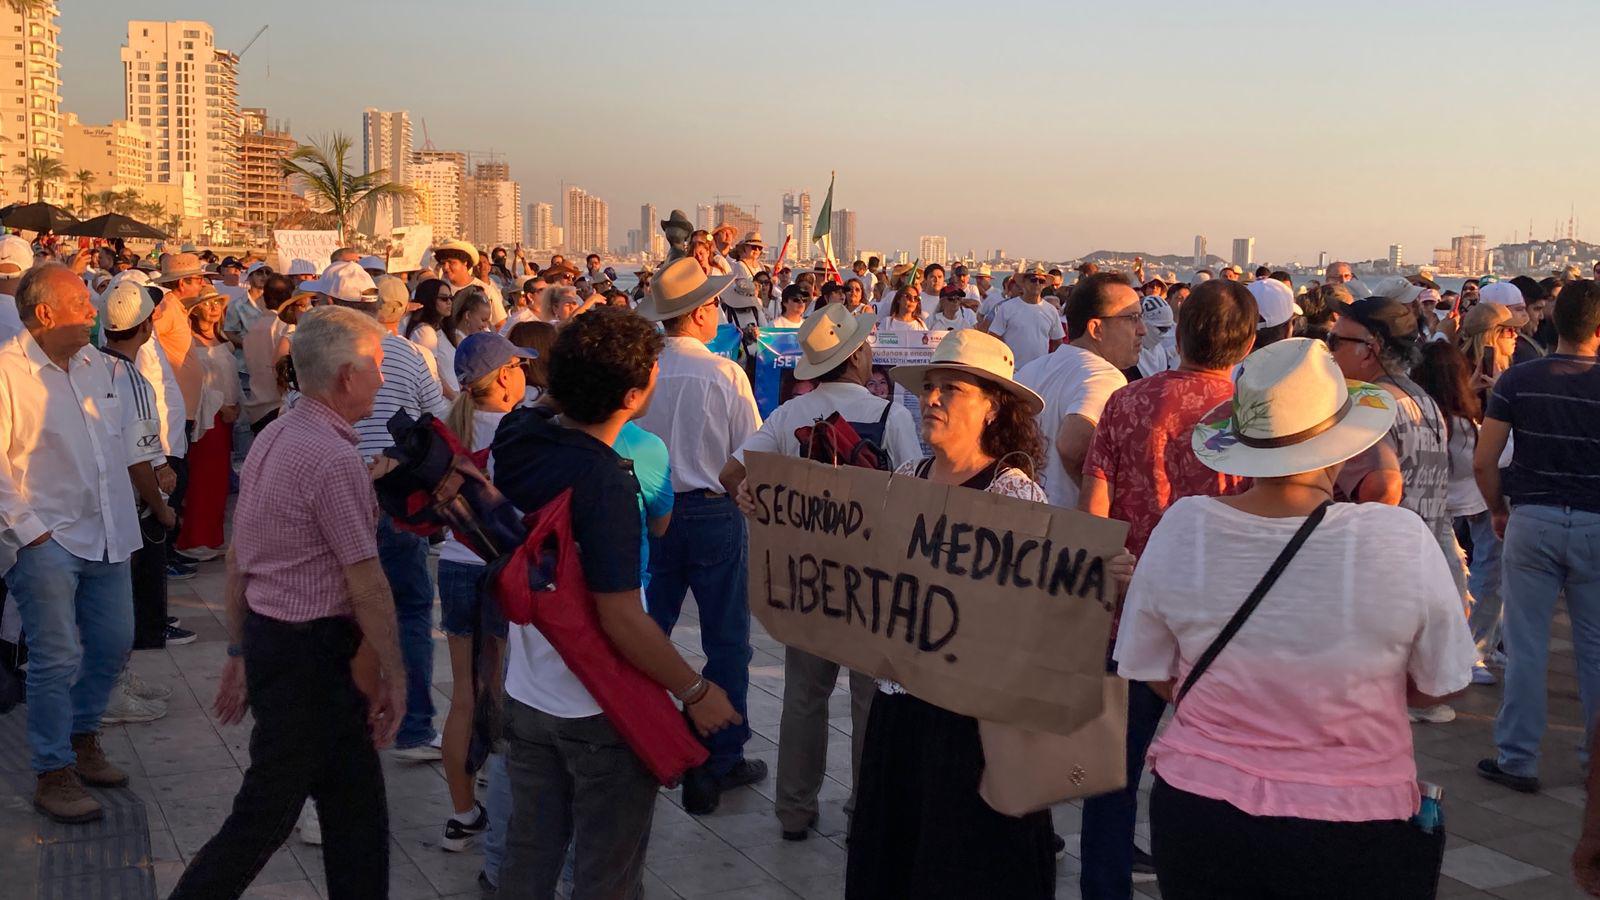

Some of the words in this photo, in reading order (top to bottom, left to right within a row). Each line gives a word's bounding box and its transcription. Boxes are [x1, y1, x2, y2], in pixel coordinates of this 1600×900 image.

[872, 350, 903, 358] yudanos
[765, 549, 959, 664] LIBERTAD.
[907, 513, 1113, 612] MEDICINA.
